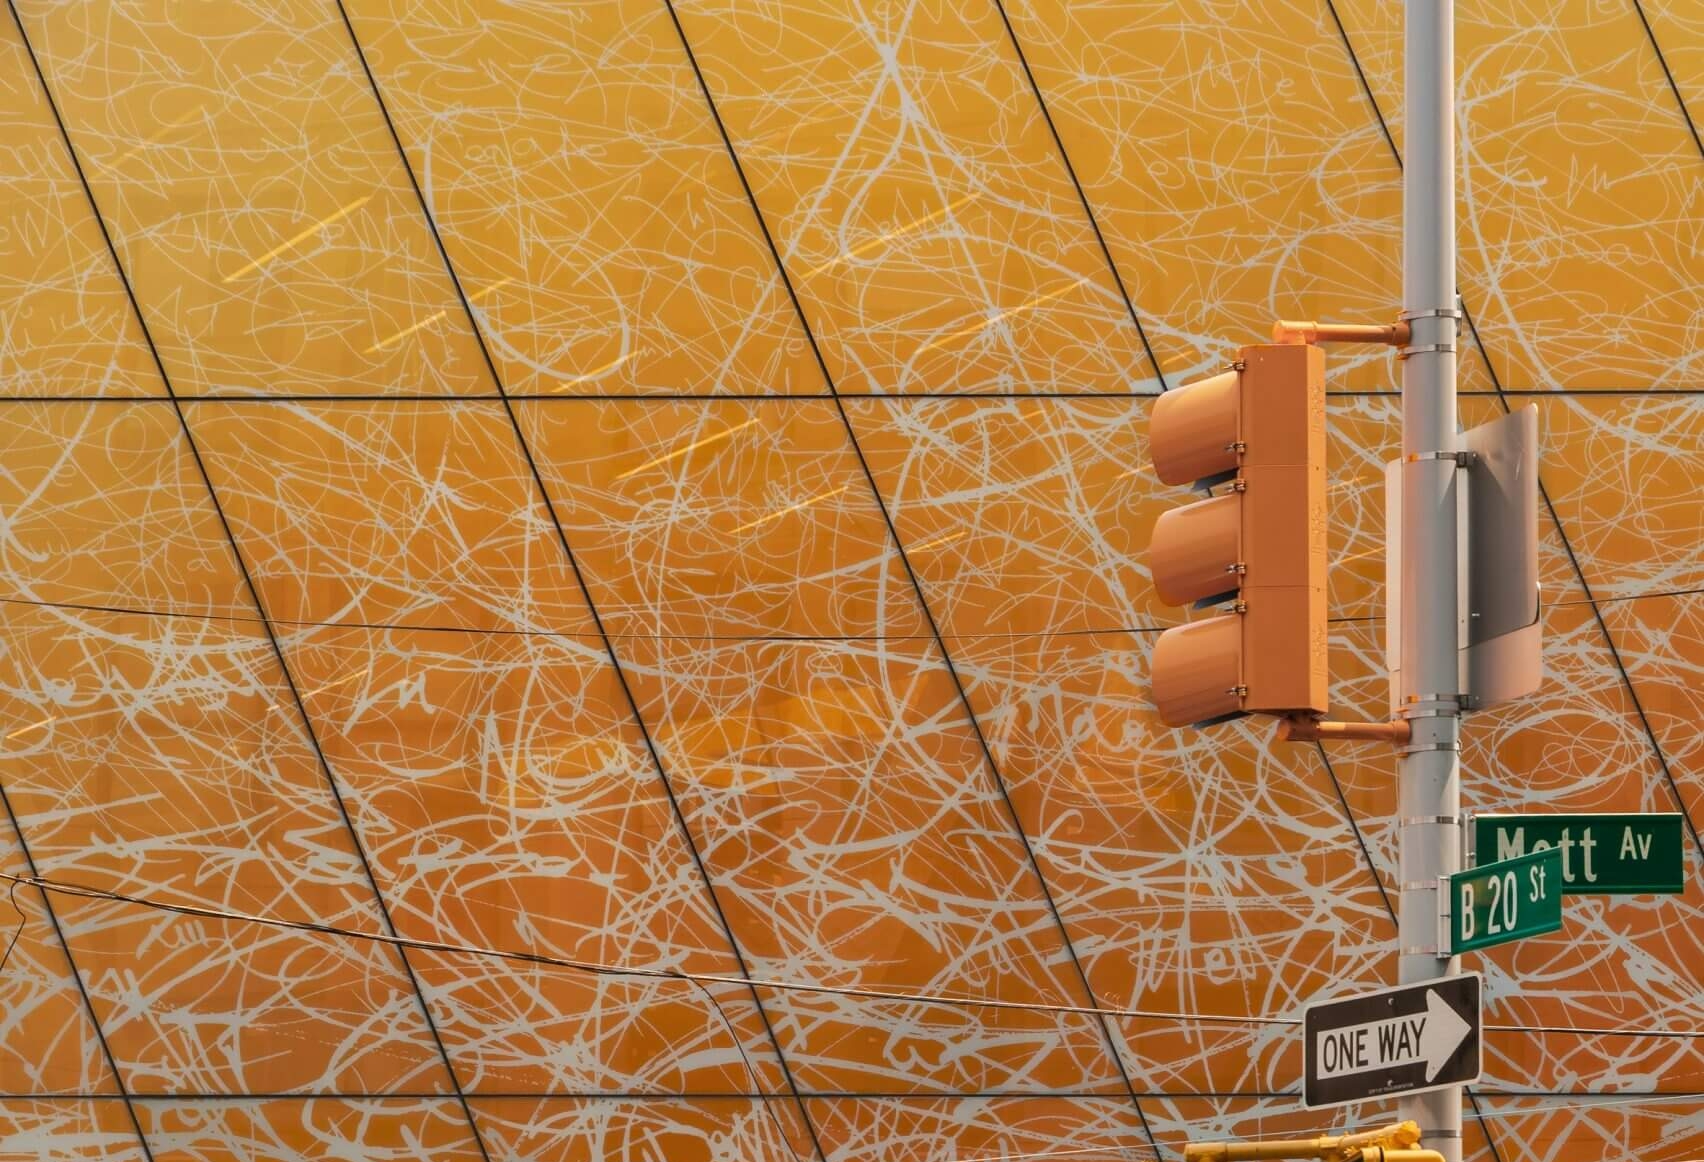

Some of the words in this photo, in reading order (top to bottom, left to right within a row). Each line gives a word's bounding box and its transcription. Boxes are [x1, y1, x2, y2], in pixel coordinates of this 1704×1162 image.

[1496, 826, 1598, 883] Mtt
[1619, 826, 1653, 861] Av
[1460, 882, 1476, 942] B
[1487, 870, 1519, 935] 20
[1528, 864, 1547, 903] St
[1322, 1028, 1369, 1073] ONE
[1378, 1016, 1427, 1063] WAY
